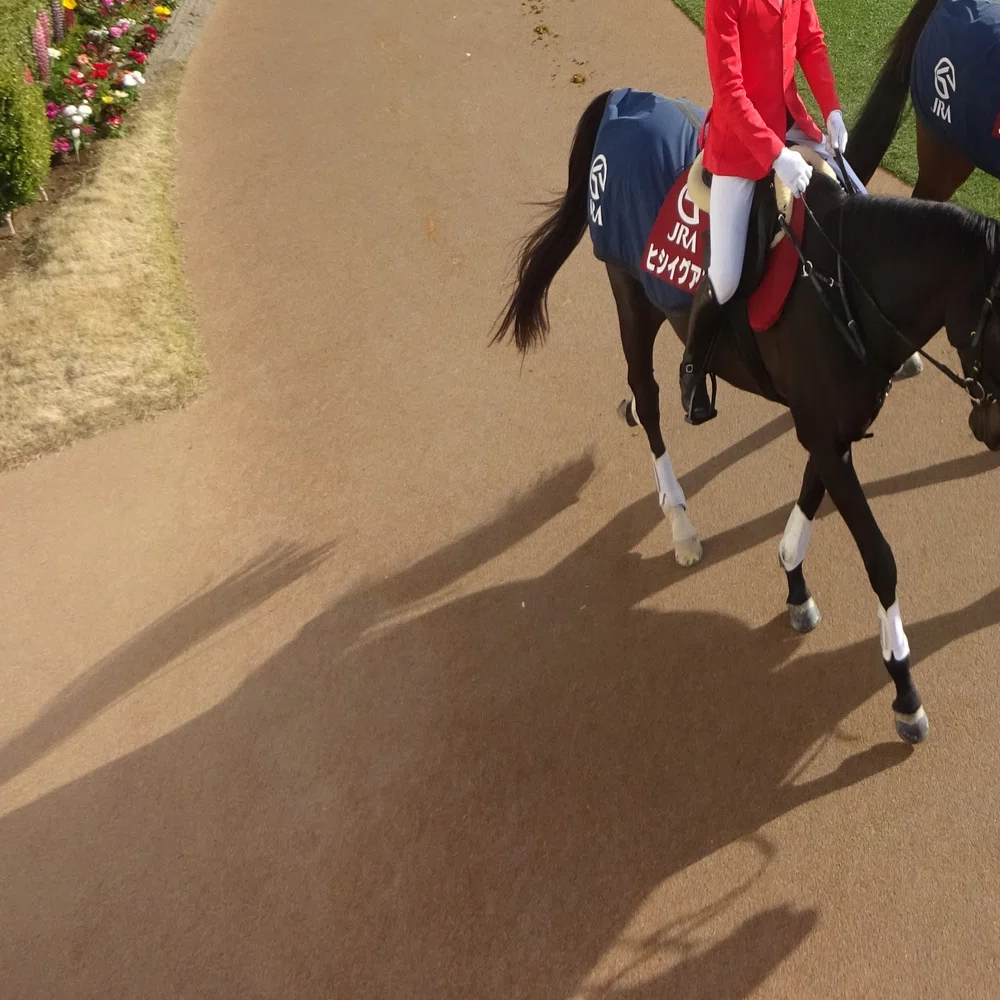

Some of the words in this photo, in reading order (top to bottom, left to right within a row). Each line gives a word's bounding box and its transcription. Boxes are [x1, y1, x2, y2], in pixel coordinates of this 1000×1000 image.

[930, 97, 952, 124] JRA
[667, 221, 698, 254] JRA
[646, 243, 705, 290] ヒシイグア
